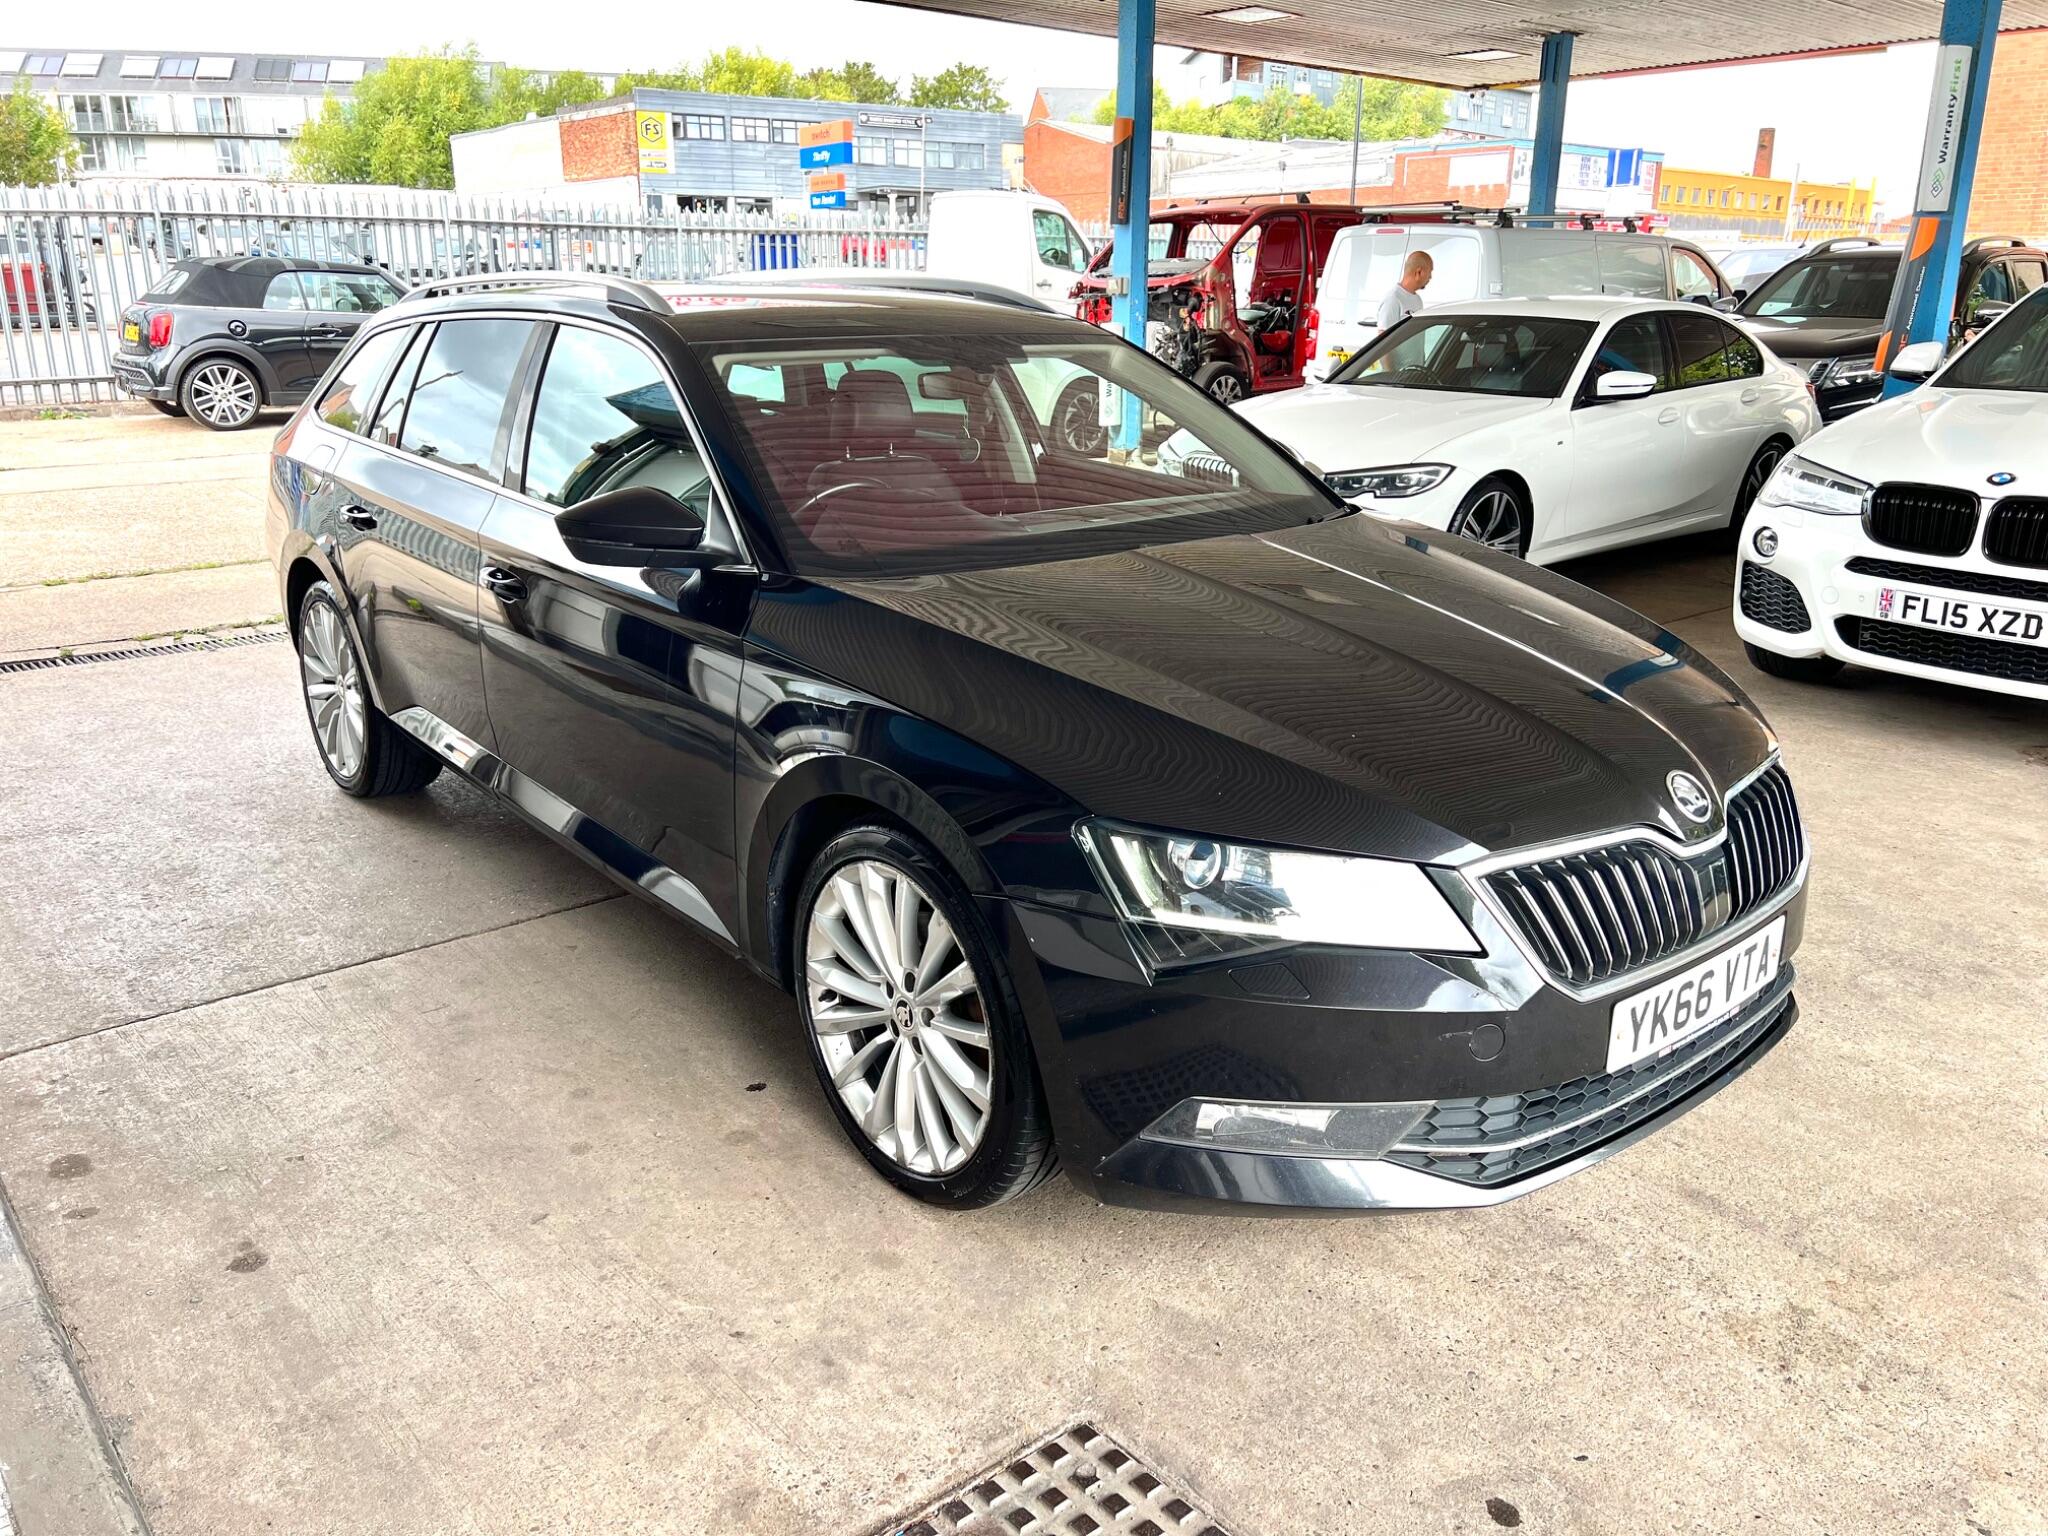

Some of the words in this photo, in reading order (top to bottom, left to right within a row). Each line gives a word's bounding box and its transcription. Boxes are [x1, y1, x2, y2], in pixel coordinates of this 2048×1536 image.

[1937, 57, 1963, 164] WarrantyFirst
[1905, 293, 1920, 331] Approved
[1915, 266, 1926, 293] Dealer
[1879, 611, 1890, 619] GB
[1901, 594, 1969, 629] FL15
[1977, 607, 2044, 640] XZD
[1630, 969, 1716, 1053] YK66
[1725, 935, 1770, 1004] VTA
